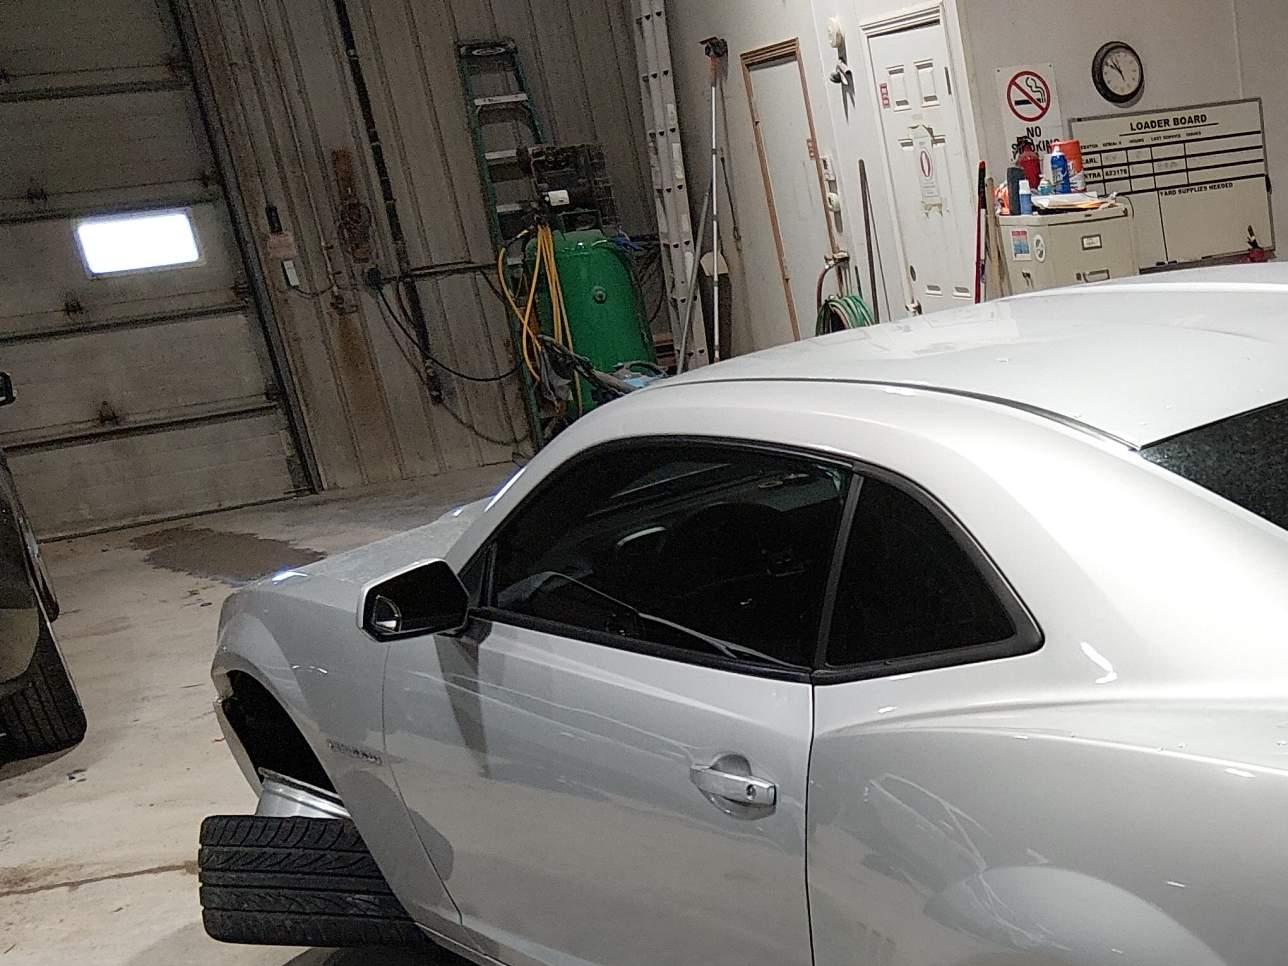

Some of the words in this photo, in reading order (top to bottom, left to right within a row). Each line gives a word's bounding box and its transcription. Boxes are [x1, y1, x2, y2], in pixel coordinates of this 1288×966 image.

[1130, 118, 1170, 132] LOADER
[1173, 114, 1208, 126] BOARD
[1026, 126, 1041, 137] NO
